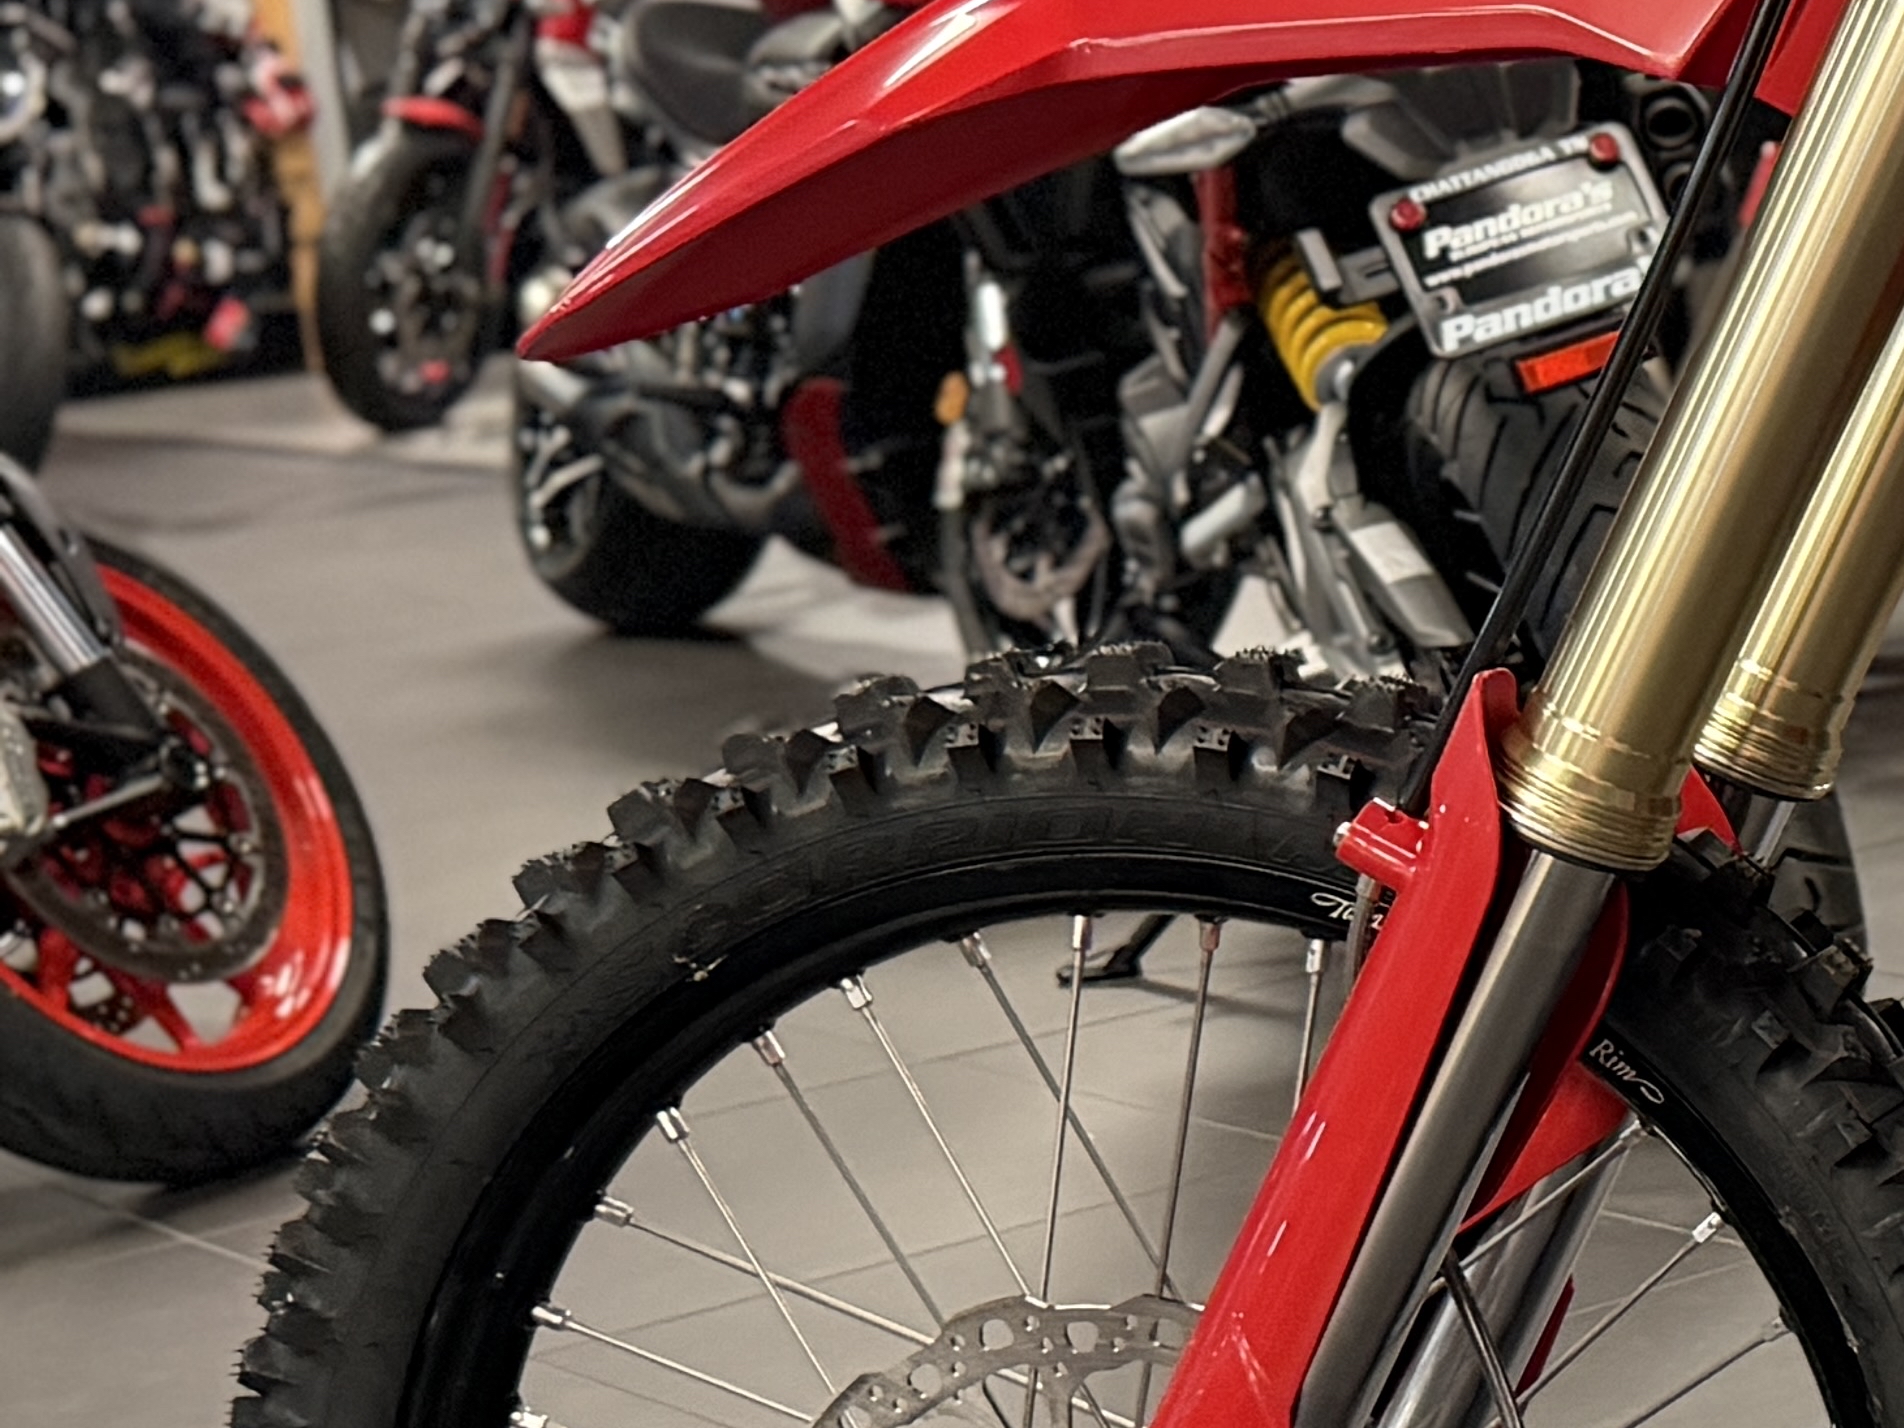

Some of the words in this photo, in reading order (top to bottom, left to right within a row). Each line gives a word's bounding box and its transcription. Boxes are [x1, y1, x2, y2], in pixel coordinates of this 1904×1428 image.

[1407, 146, 1555, 202] CHATTANOOGA
[1422, 179, 1614, 259] Pandora's
[1441, 254, 1653, 352] Pandora'
[1588, 1038, 1666, 1105] Rim
